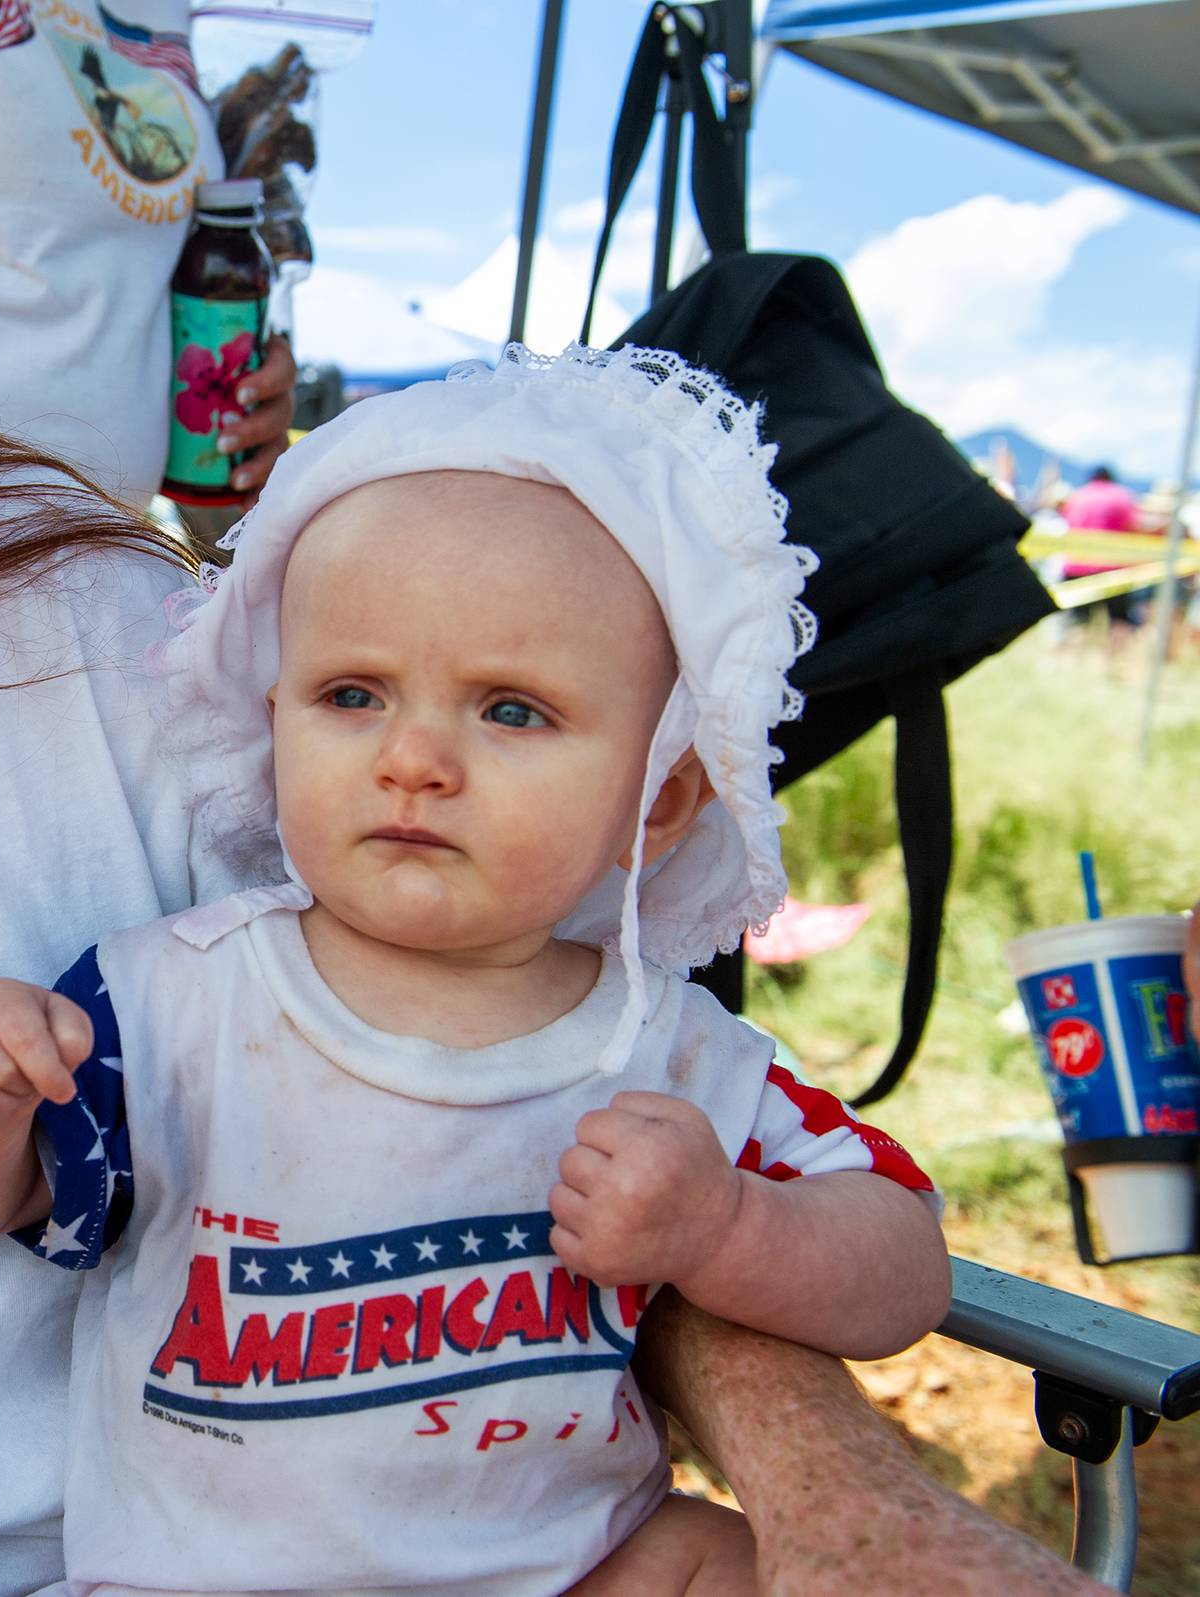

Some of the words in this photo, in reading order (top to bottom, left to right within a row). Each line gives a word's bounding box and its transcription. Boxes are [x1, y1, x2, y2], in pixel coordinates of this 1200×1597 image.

[150, 1254, 591, 1387] AMERICAN
[179, 1417, 206, 1434] Amigos
[206, 1425, 230, 1441] T-Shirt
